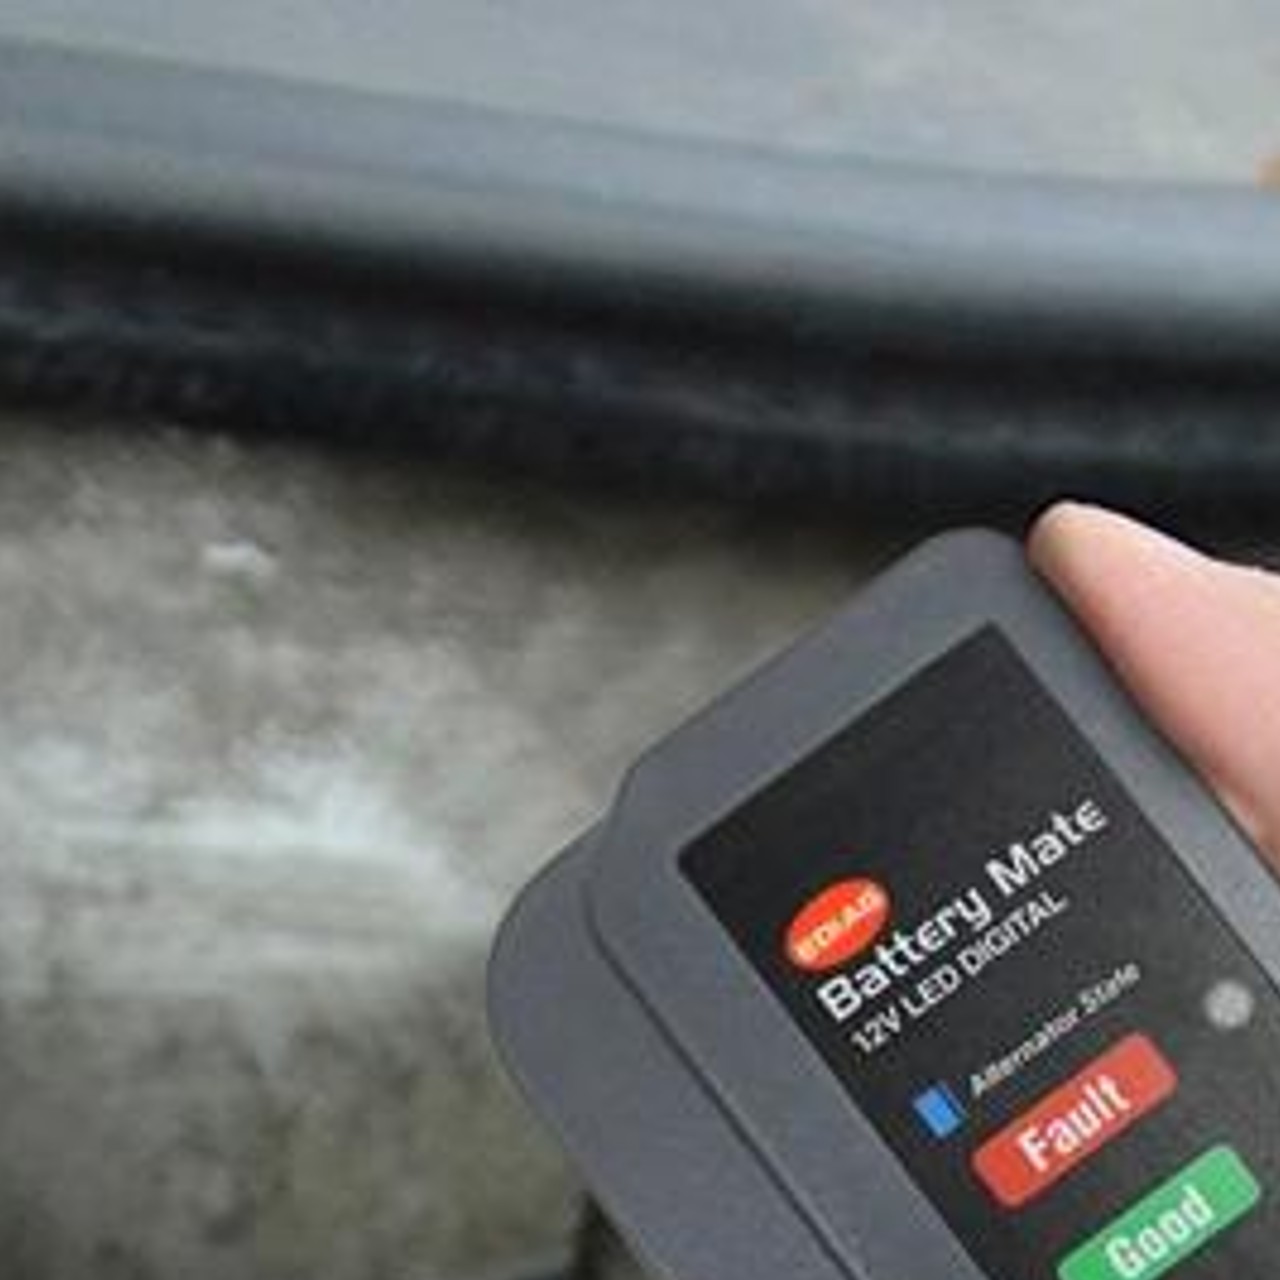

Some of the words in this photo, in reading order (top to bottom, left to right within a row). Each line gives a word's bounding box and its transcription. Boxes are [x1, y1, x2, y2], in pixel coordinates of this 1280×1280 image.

[817, 887, 992, 1020] Battery
[984, 799, 1108, 897] Mate
[850, 1006, 904, 1052] 12V
[899, 962, 963, 1017] LED
[955, 889, 1068, 975] DIGITAL
[969, 1006, 1081, 1096] Alternator
[1078, 961, 1141, 1014] State
[1017, 1072, 1132, 1172] Fault
[1104, 1182, 1214, 1280] Good
